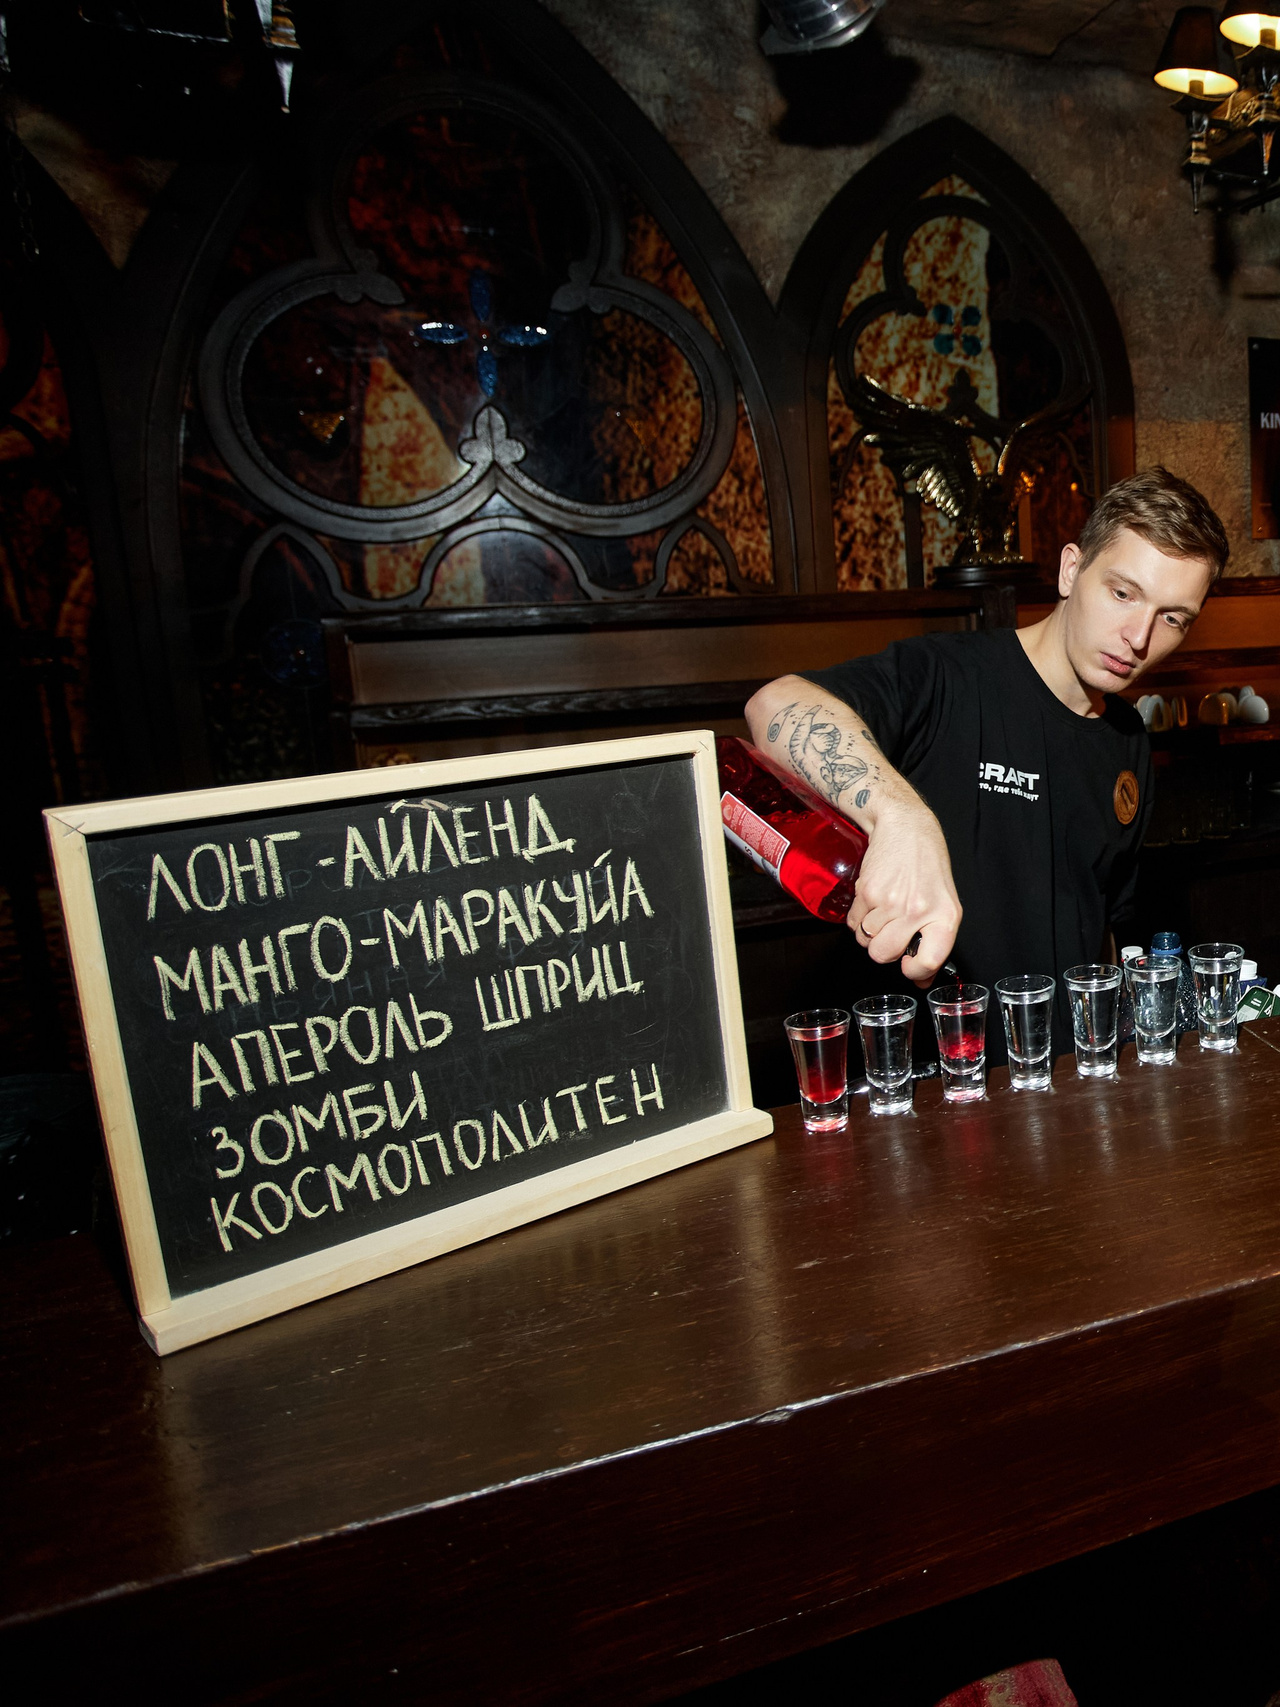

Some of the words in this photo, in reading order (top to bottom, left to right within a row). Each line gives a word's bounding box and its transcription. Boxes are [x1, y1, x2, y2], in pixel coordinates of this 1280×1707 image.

[191, 993, 454, 1110] АПЕРОЛЬ
[474, 940, 645, 1032] ШПРИЦ
[210, 1070, 429, 1179] ЗОМБИ
[210, 1062, 666, 1253] КОСМОПОЛИТЕН
